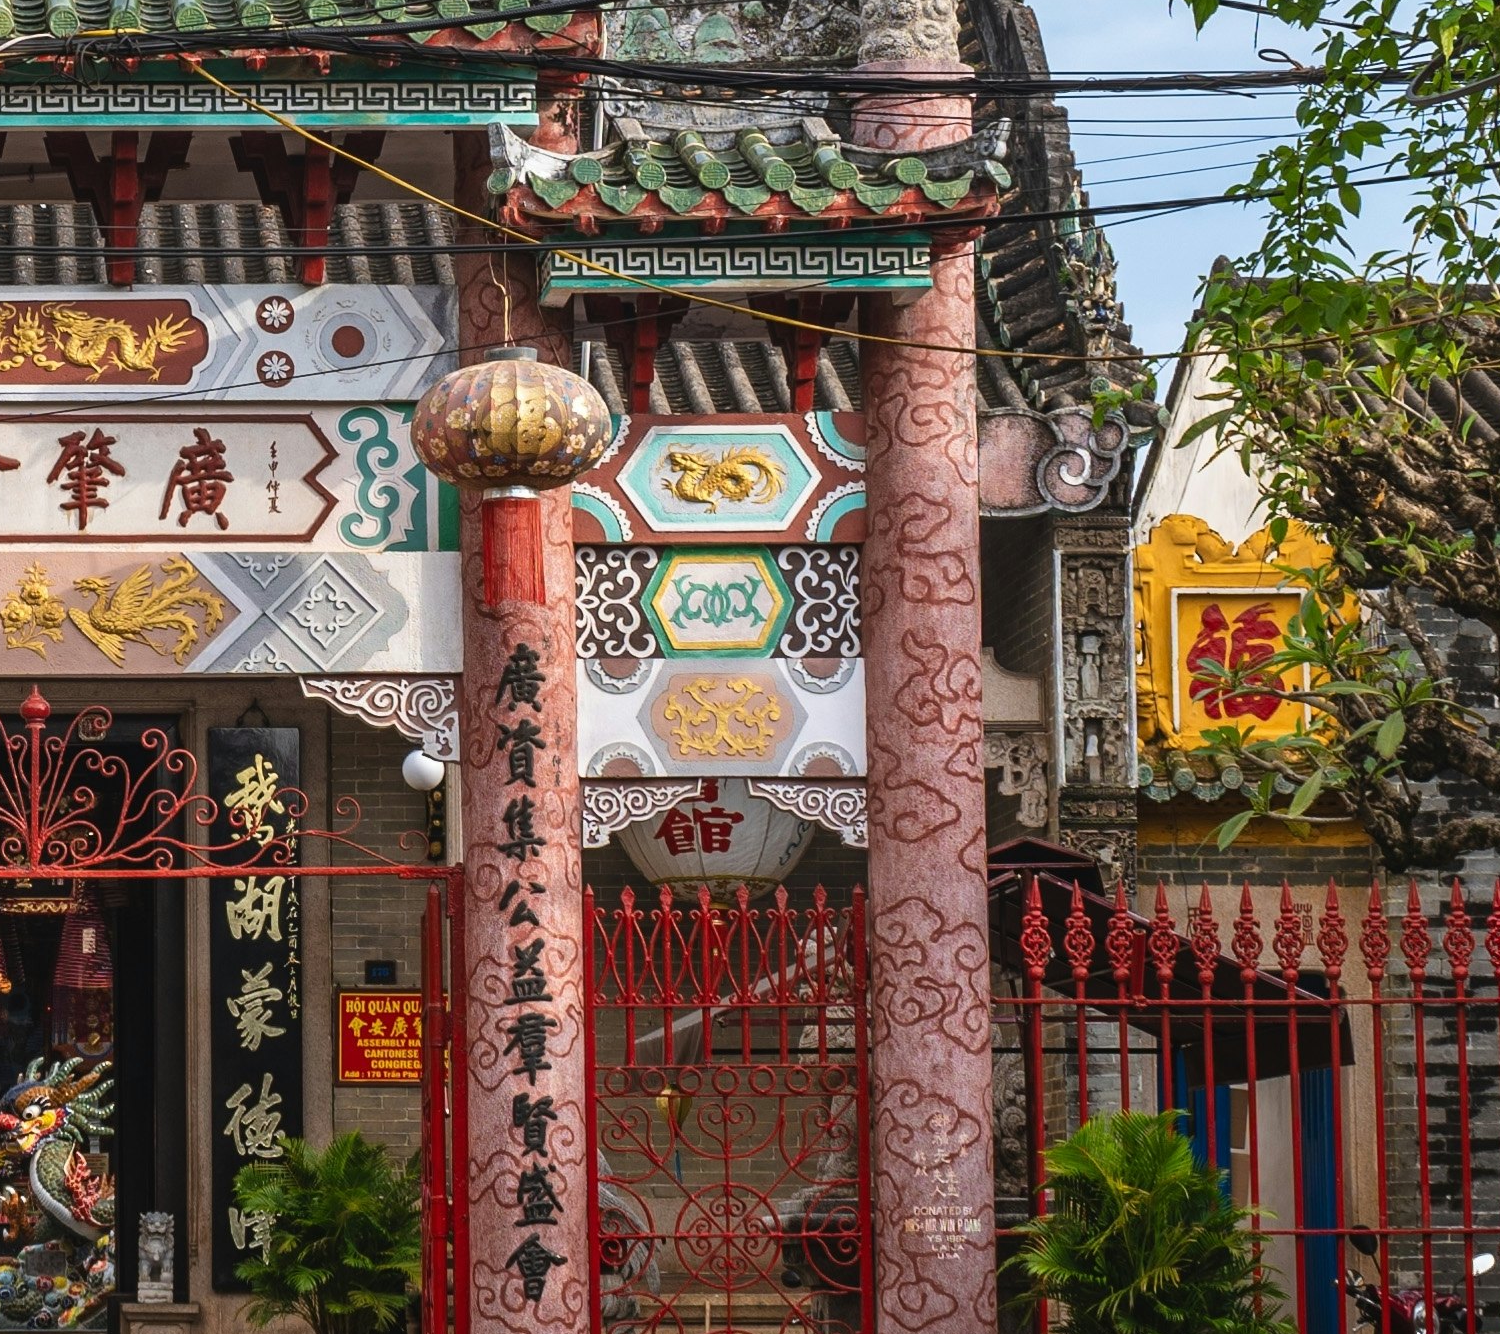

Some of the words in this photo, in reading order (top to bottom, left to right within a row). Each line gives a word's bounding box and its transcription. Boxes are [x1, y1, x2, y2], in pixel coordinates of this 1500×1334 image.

[1186, 602, 1286, 722] 福
[345, 996, 366, 1016] HỘI
[367, 997, 401, 1016] QUÁN
[357, 1038, 406, 1047] ASSEMBLY
[364, 1049, 419, 1059] CANTONESE
[913, 1206, 962, 1216] DONATED
